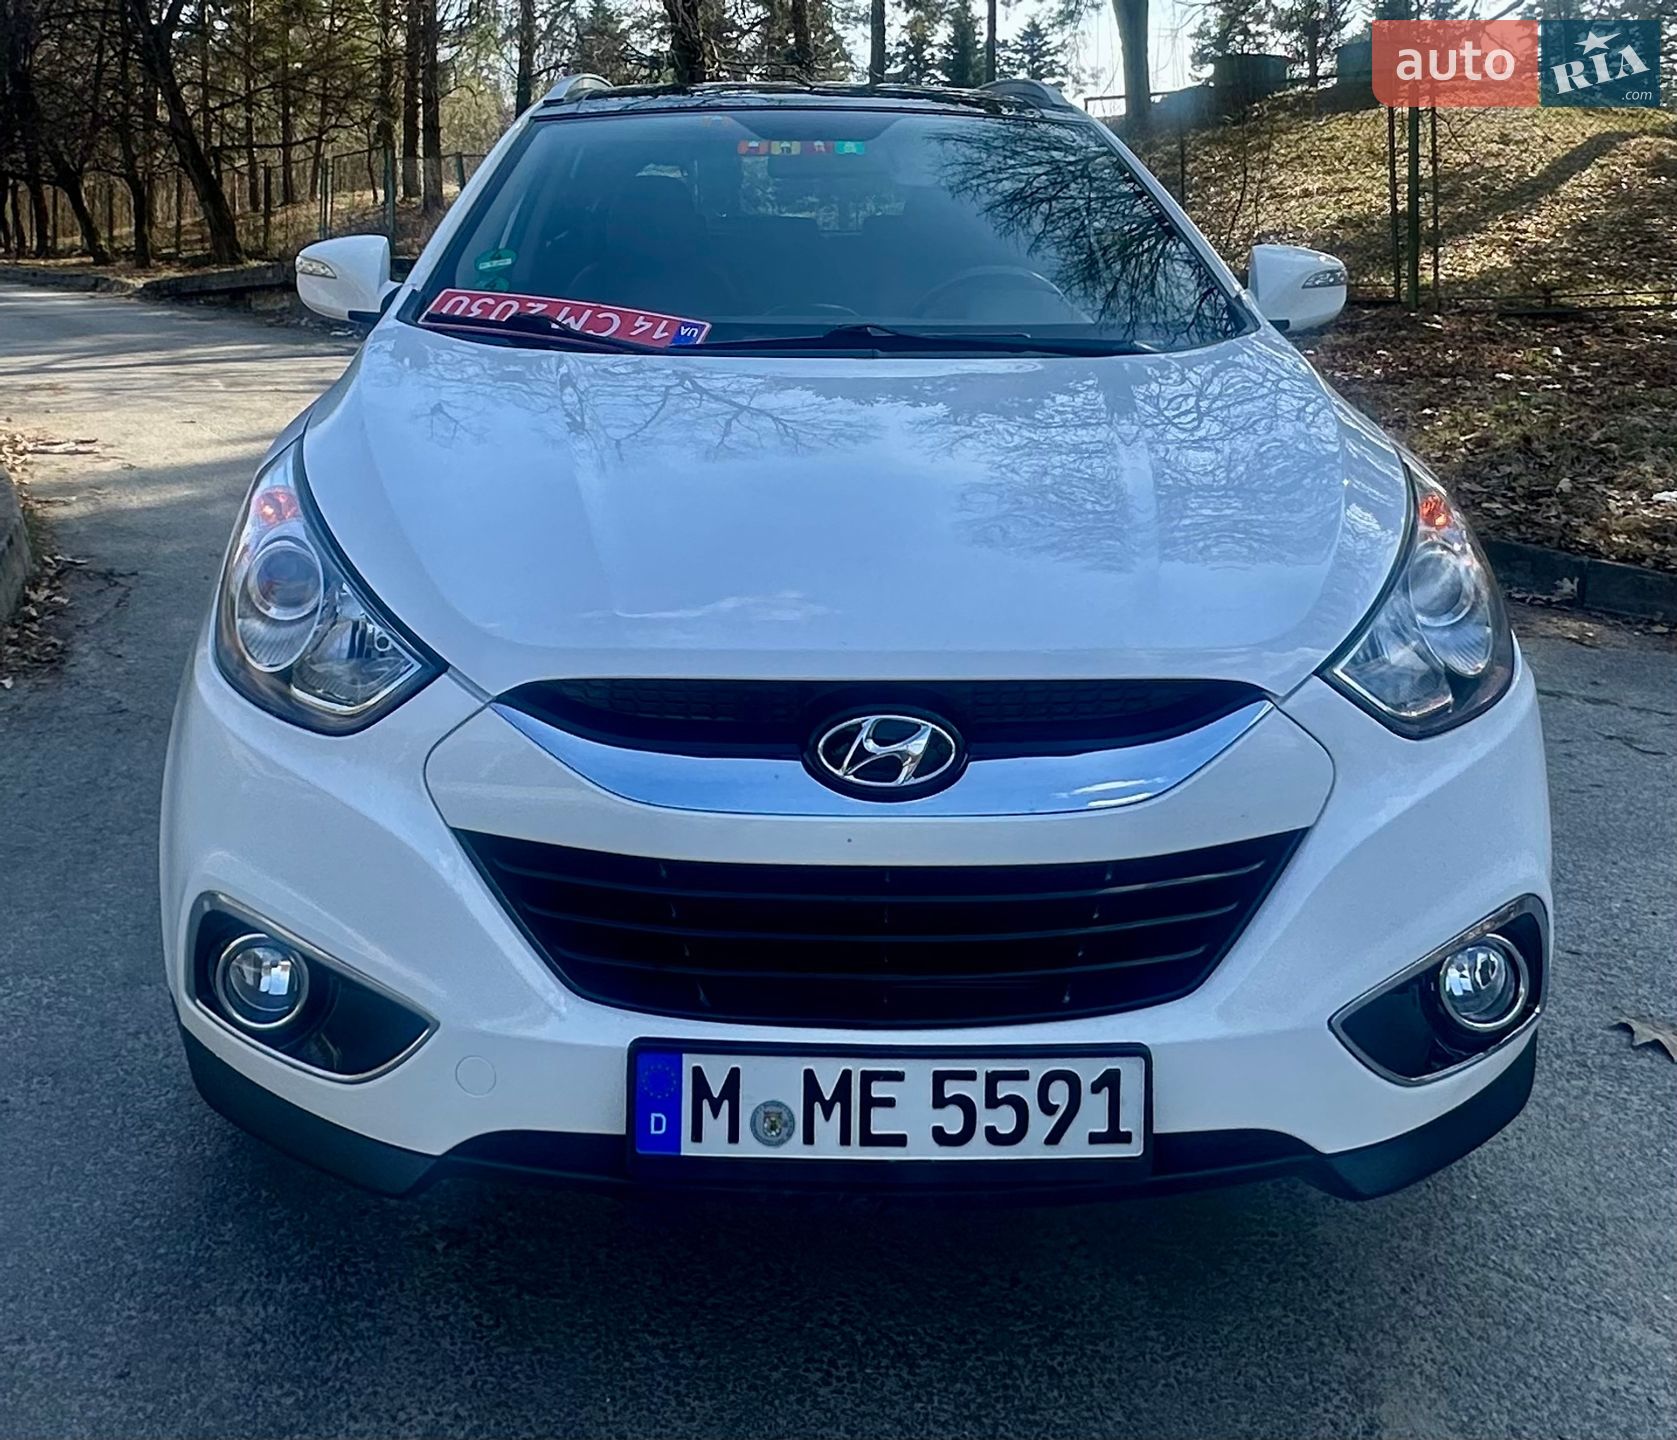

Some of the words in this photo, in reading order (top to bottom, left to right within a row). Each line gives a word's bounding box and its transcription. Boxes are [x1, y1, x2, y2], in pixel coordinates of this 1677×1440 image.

[551, 307, 621, 337] CM
[630, 316, 669, 339] 14
[680, 326, 699, 337] UA
[691, 1065, 741, 1144] M
[802, 1068, 908, 1147] ME
[931, 1068, 1133, 1147] 5591
[650, 1113, 666, 1135] D
